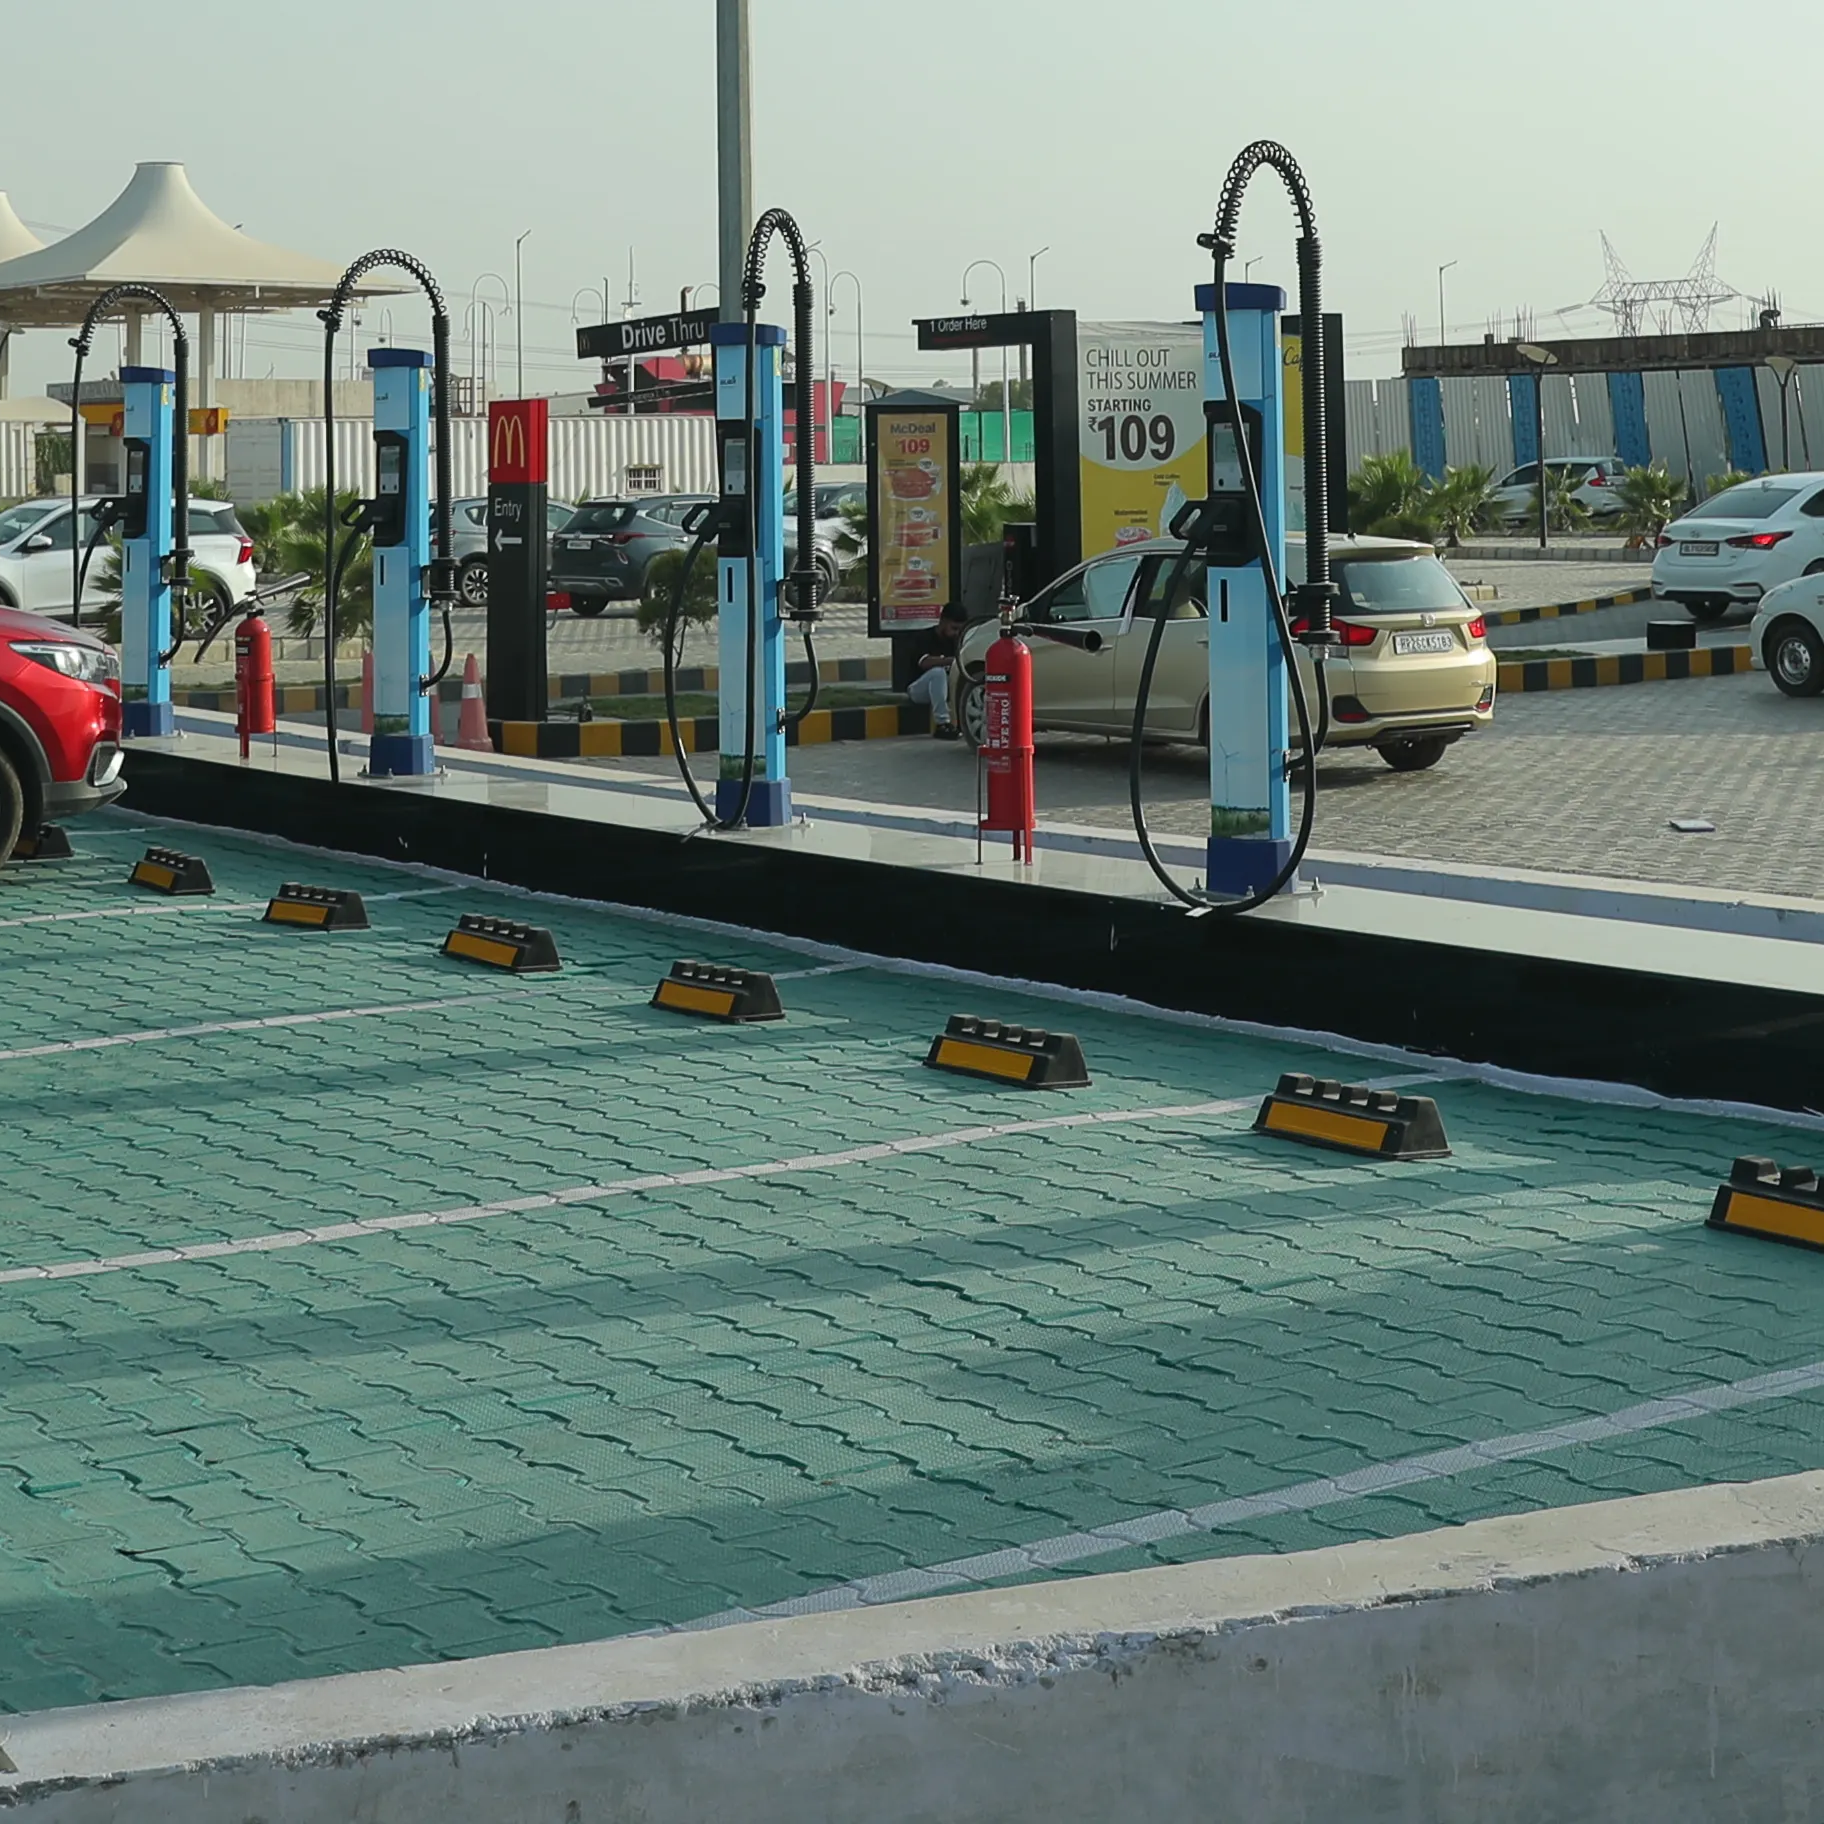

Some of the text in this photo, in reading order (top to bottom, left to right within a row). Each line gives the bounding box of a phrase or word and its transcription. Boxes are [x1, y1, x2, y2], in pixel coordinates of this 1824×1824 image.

[621, 317, 705, 350] Drive Thru
[930, 317, 988, 333] 1 Order Here
[1086, 348, 1171, 368] CHILL OUT
[1086, 370, 1197, 390] THIS SUMMER
[1087, 398, 1152, 413] STARTING
[890, 422, 936, 435] McDeal
[494, 497, 523, 523] Entry
